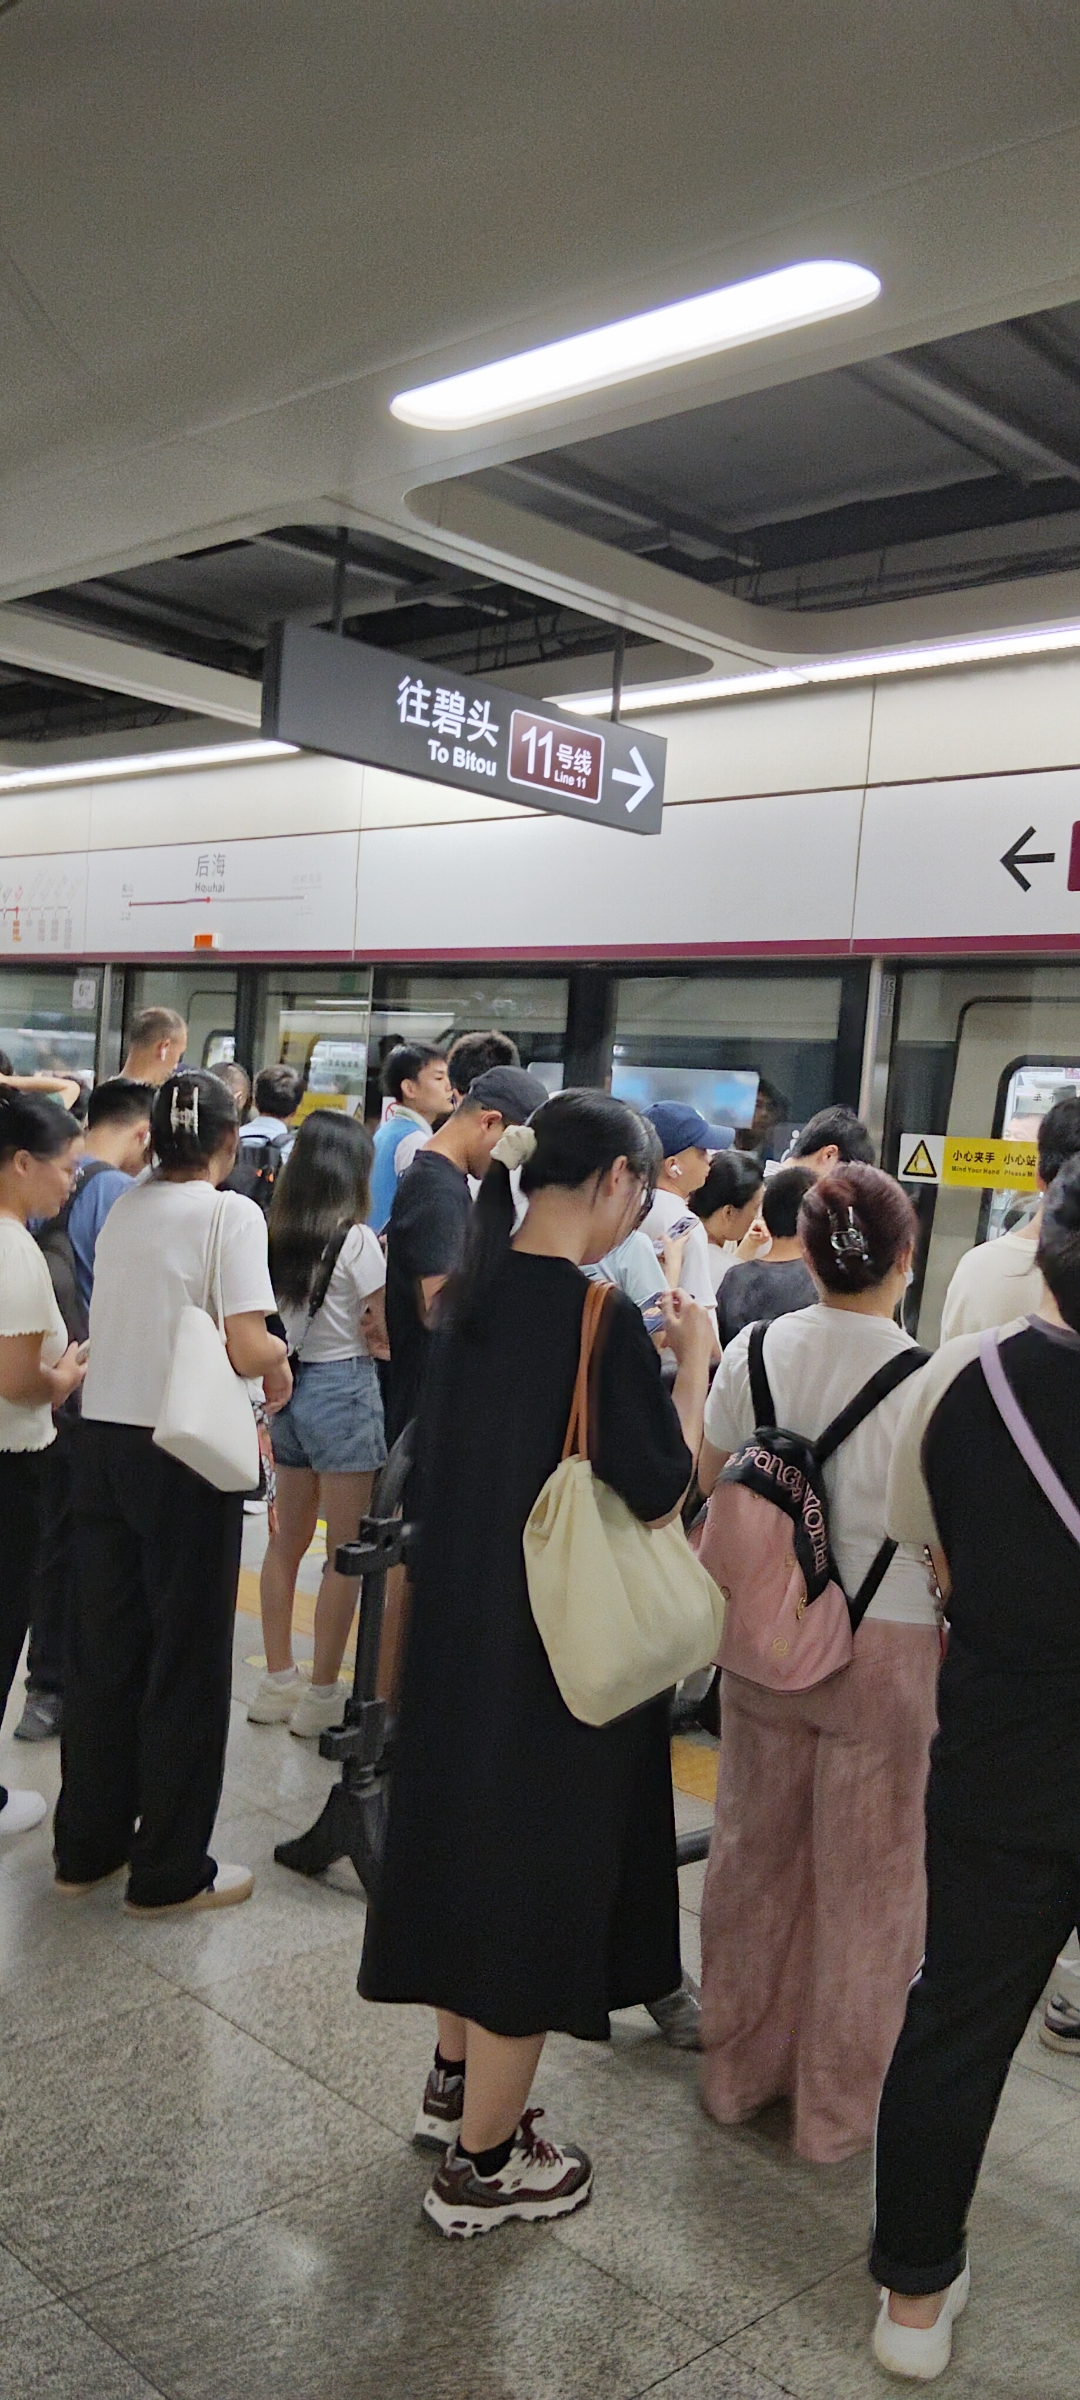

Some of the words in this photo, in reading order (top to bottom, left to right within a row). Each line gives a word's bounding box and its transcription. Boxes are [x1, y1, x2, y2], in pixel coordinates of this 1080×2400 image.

[397, 675, 499, 747] 往碧头
[428, 739, 449, 763] To
[453, 746, 497, 777] Bitou
[554, 769, 575, 786] Line
[576, 776, 587, 789] 11
[195, 853, 226, 877] 后海
[195, 882, 225, 893] Houhai
[953, 1150, 995, 1163] 小心夹手
[952, 1165, 967, 1173] Mind
[968, 1166, 982, 1174] Your
